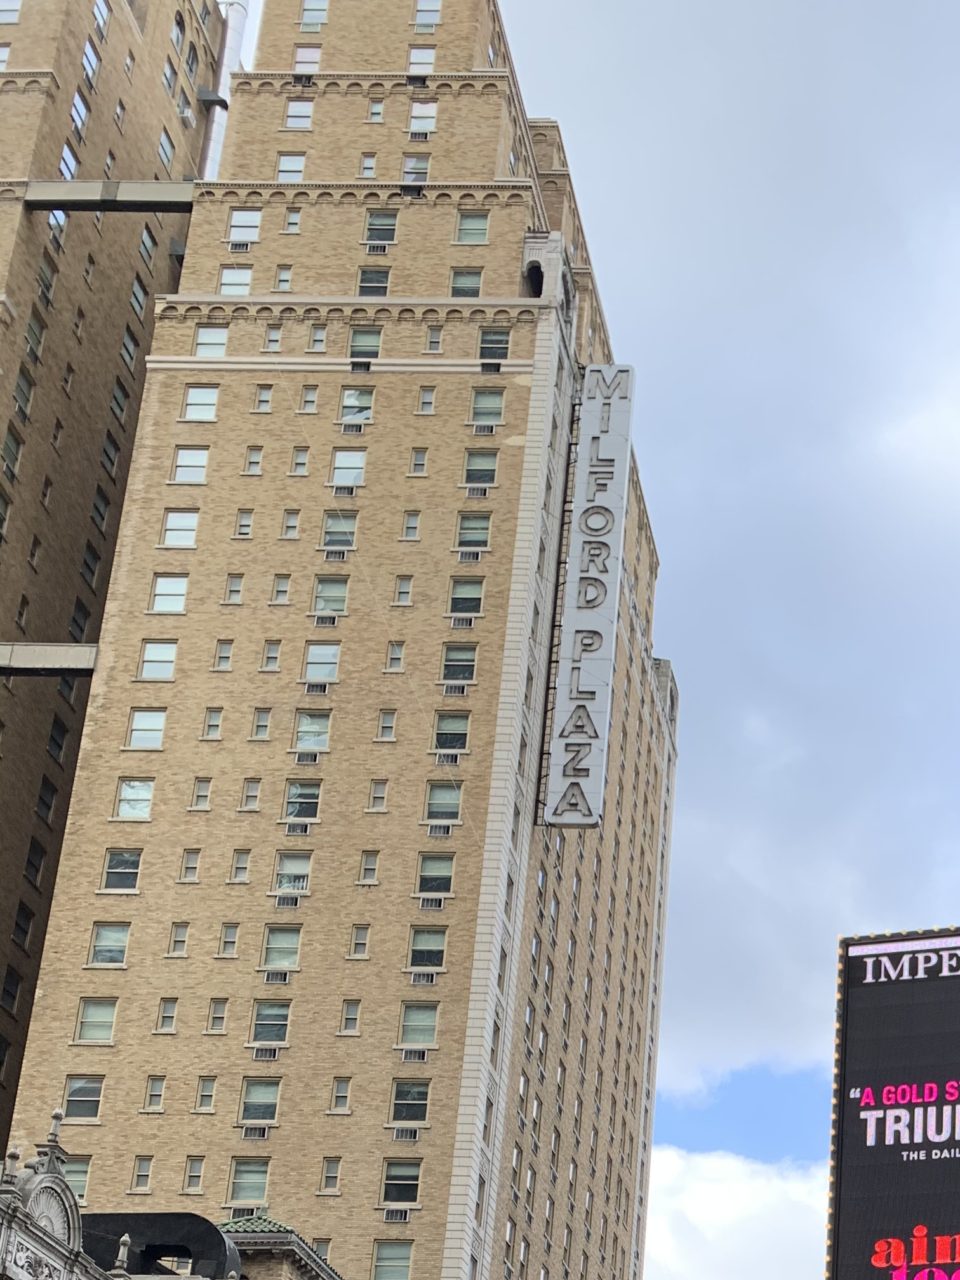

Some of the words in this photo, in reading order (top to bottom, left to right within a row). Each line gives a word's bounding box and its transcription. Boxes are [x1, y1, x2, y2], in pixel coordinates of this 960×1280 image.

[576, 369, 631, 610] MILFORD
[552, 629, 603, 817] PLAZA
[882, 1082, 938, 1106] GOLD
[901, 1150, 927, 1162] THE
